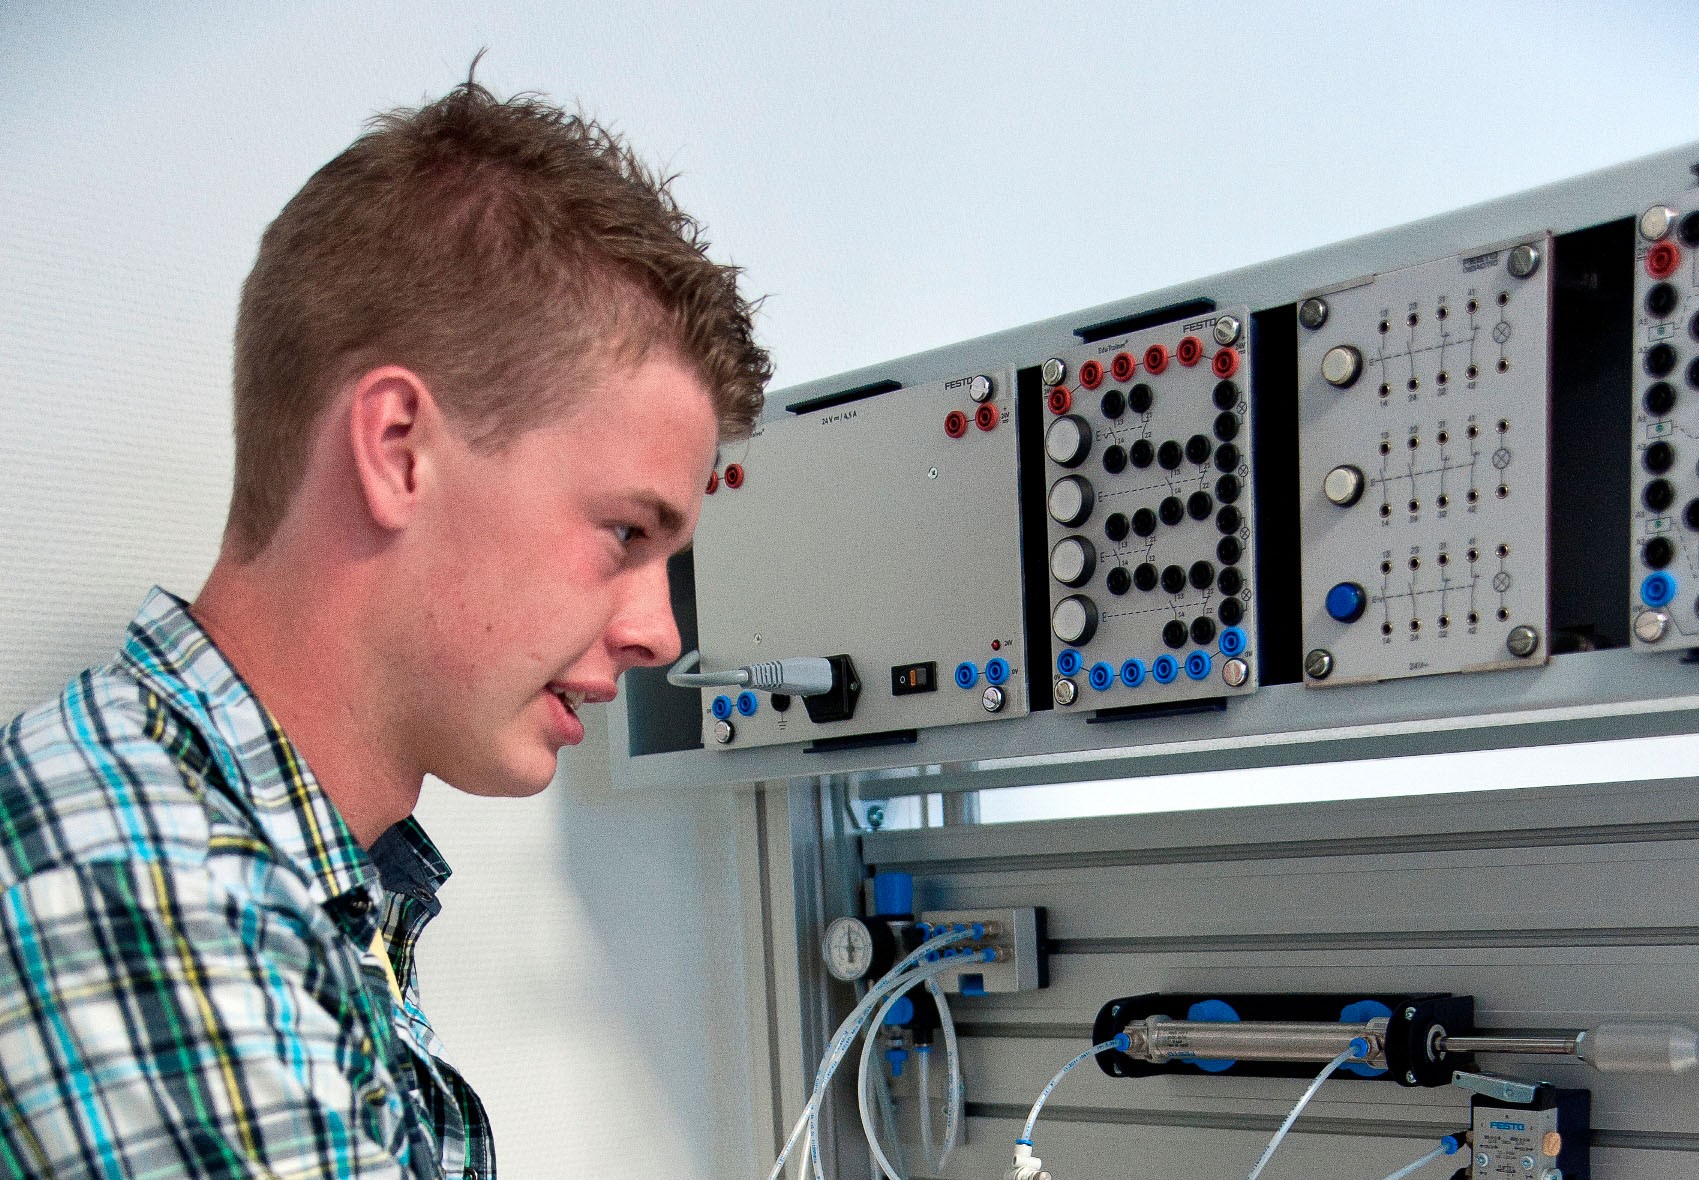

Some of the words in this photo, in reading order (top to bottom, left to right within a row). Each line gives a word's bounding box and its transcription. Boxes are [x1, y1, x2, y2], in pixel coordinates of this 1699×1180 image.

[1183, 317, 1217, 334] FESTO
[945, 376, 973, 391] FESTO
[1490, 1121, 1525, 1131] FESTO
